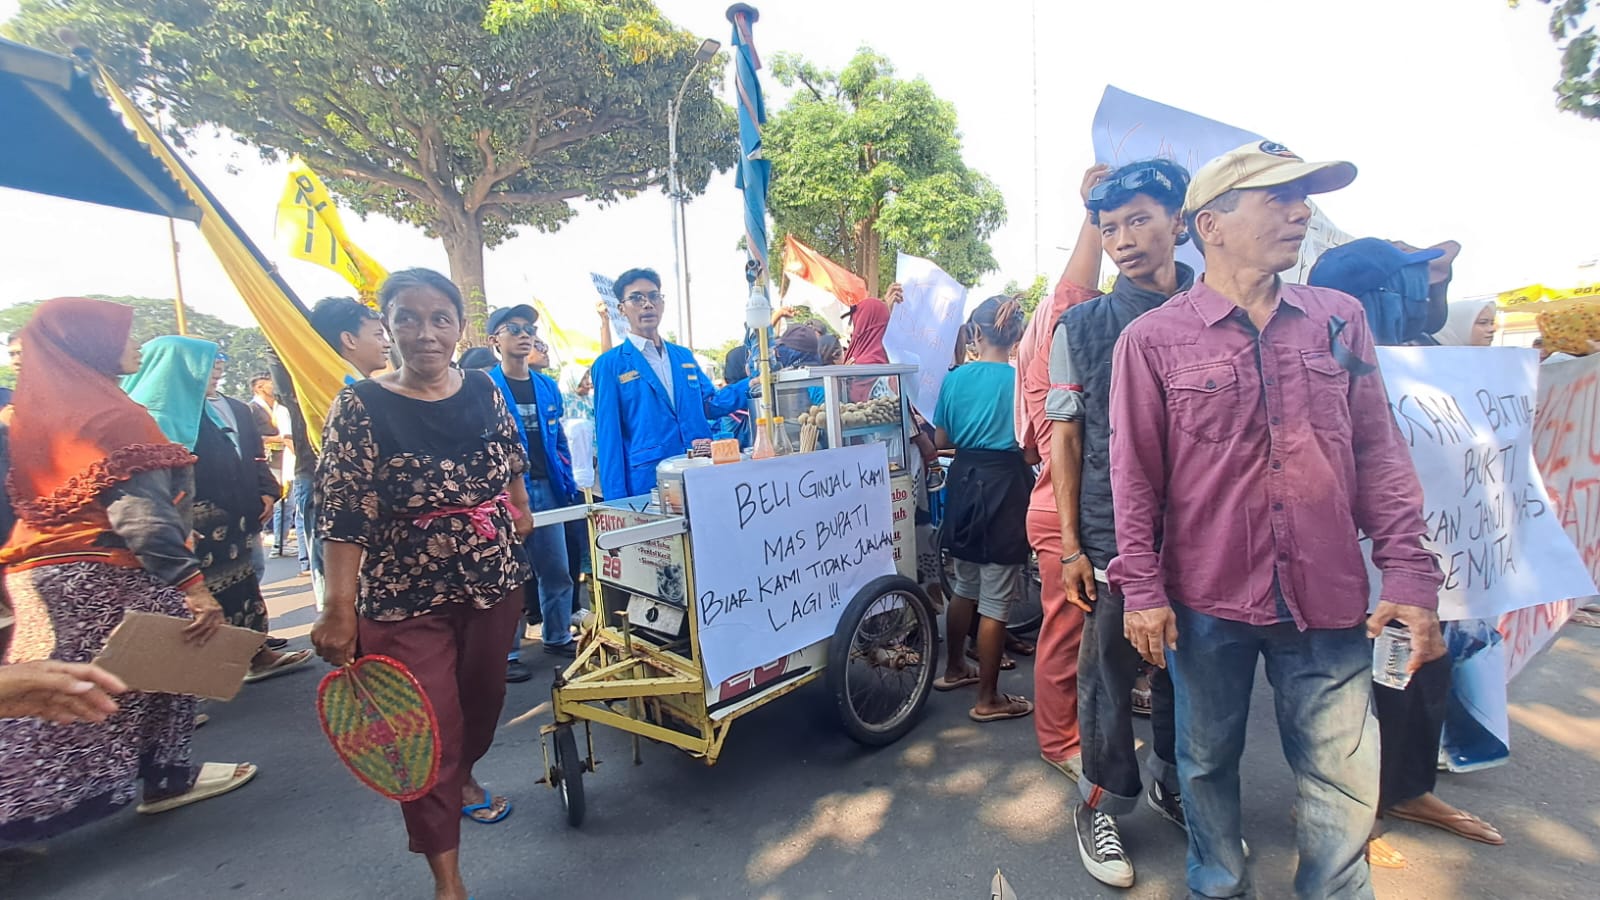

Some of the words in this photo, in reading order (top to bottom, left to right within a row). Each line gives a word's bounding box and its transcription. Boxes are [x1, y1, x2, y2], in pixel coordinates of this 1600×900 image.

[1390, 394, 1478, 447] KAMI
[734, 480, 791, 530] BELI
[798, 469, 852, 499] GINJAL
[857, 462, 886, 489] KAMI
[1462, 444, 1517, 498] BUKTI
[763, 530, 807, 565] MAS
[815, 503, 869, 551] BUPATI
[602, 555, 621, 579] 28
[700, 588, 752, 626] BIAR
[757, 567, 801, 603] KAMI
[805, 553, 852, 579] TIDAK
[767, 592, 822, 632] LAGI
[828, 582, 841, 609] !!!
